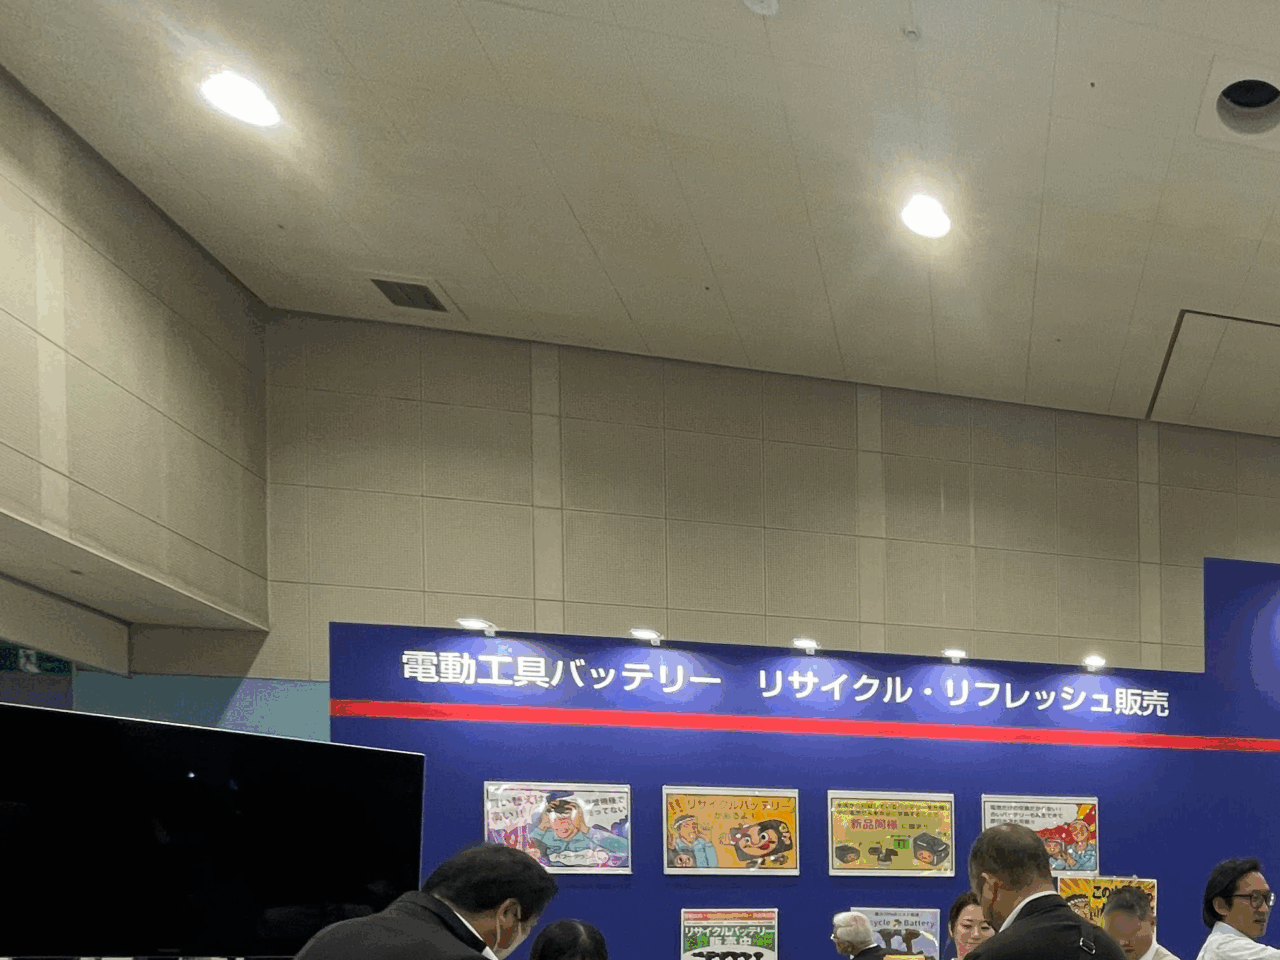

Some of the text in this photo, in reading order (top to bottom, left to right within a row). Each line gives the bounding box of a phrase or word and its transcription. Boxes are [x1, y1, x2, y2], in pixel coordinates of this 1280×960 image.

[402, 650, 721, 694] 電動工具バッテリー
[759, 669, 1170, 717] リサイクル・リフレッシュ販売
[685, 926, 776, 937] リサイクルバッテリー
[871, 919, 935, 929] ycle Battery
